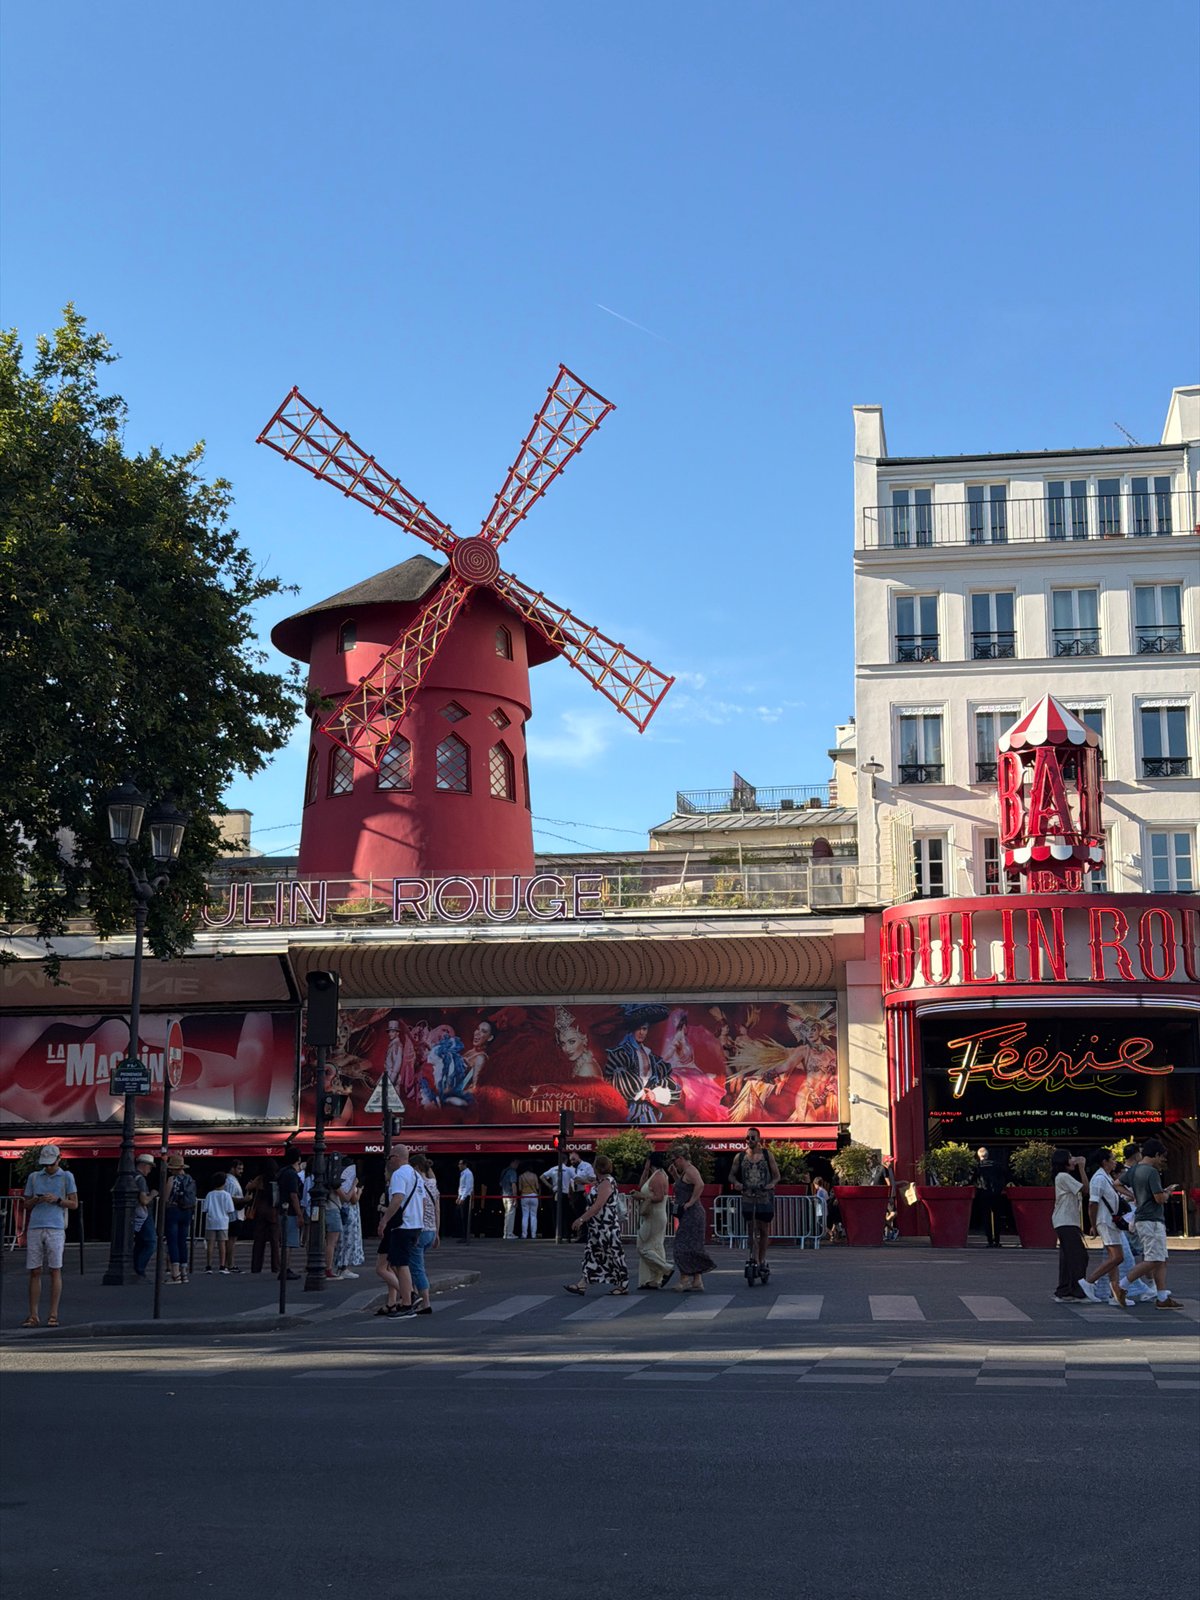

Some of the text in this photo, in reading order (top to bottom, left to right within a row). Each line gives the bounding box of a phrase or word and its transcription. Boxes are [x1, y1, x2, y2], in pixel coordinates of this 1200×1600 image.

[1038, 870, 1082, 892] DU
[200, 873, 604, 927] ULIN ROUGE
[47, 1044, 65, 1063] LA
[948, 1021, 1176, 1098] Féerie
[511, 1098, 595, 1114] MOULIN ROUGE
[1091, 1113, 1113, 1122] MONDE
[994, 1126, 1079, 1136] LES DORISS GIRLS
